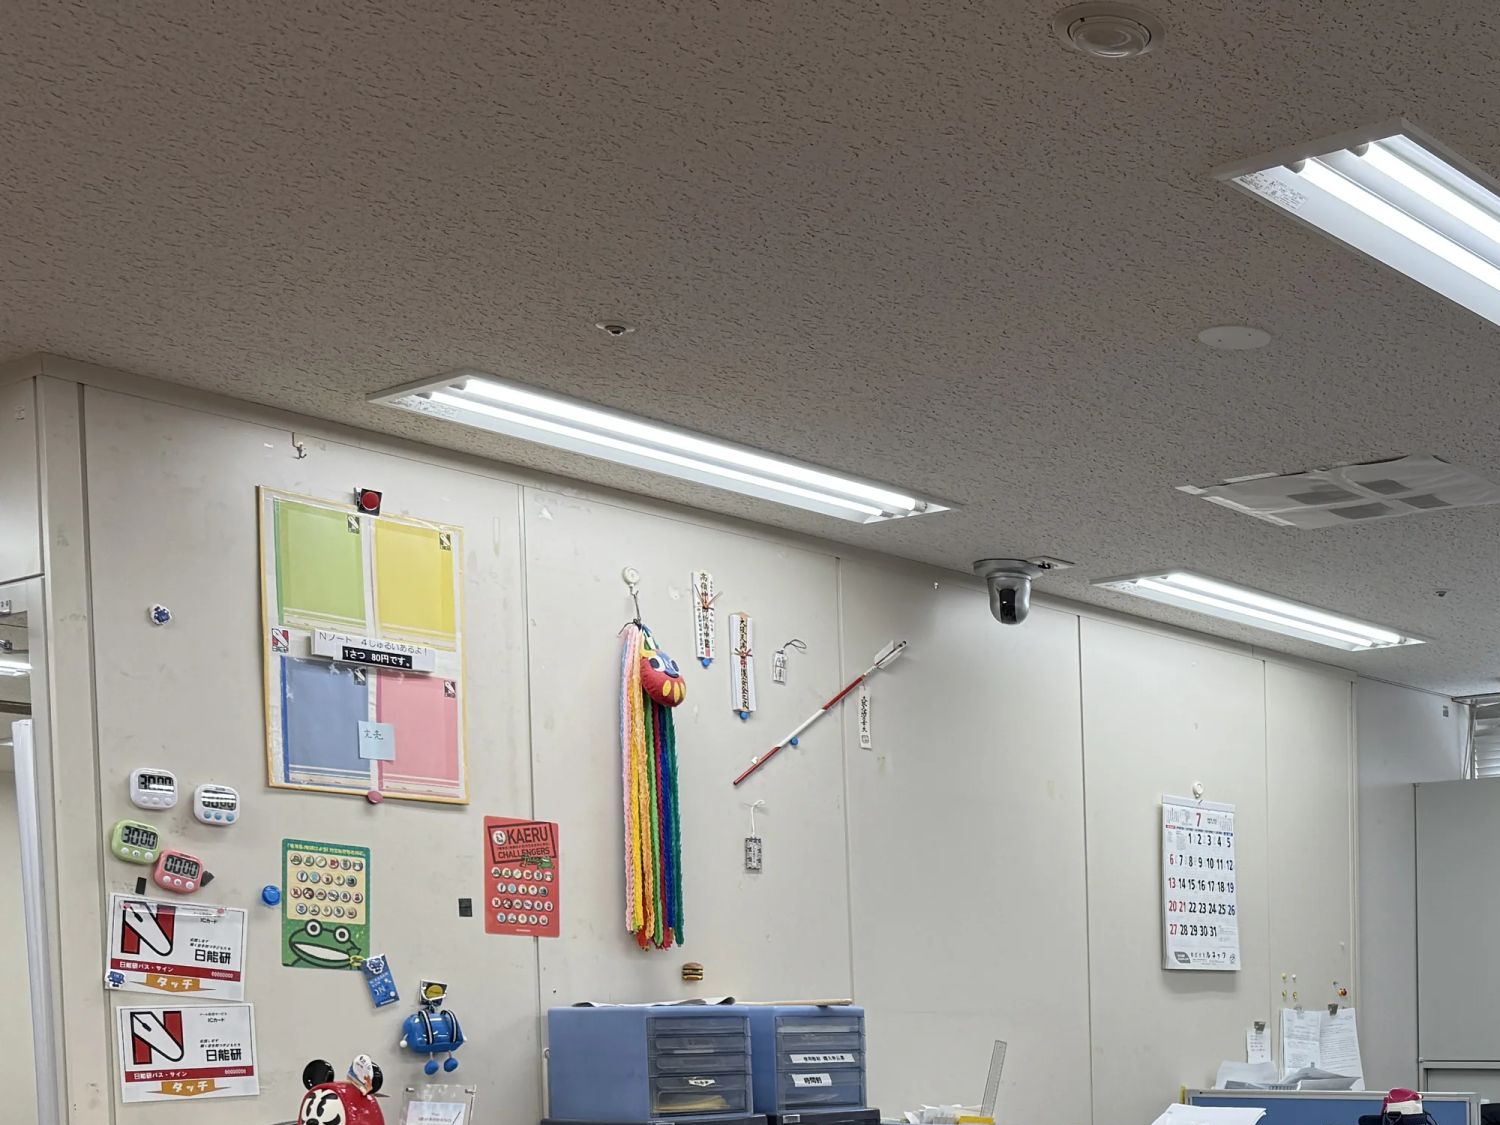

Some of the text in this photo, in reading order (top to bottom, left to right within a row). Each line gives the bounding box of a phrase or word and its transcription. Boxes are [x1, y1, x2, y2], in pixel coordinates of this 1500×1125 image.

[345, 649, 366, 659] 1さつ
[1196, 813, 1201, 827] 7
[507, 826, 549, 845] KAERU
[498, 847, 551, 859] CHALLENGERS
[194, 949, 231, 965] 日能研
[156, 977, 193, 990] タッチ
[206, 1048, 242, 1062] 日能研
[172, 1081, 209, 1092] タッチ
